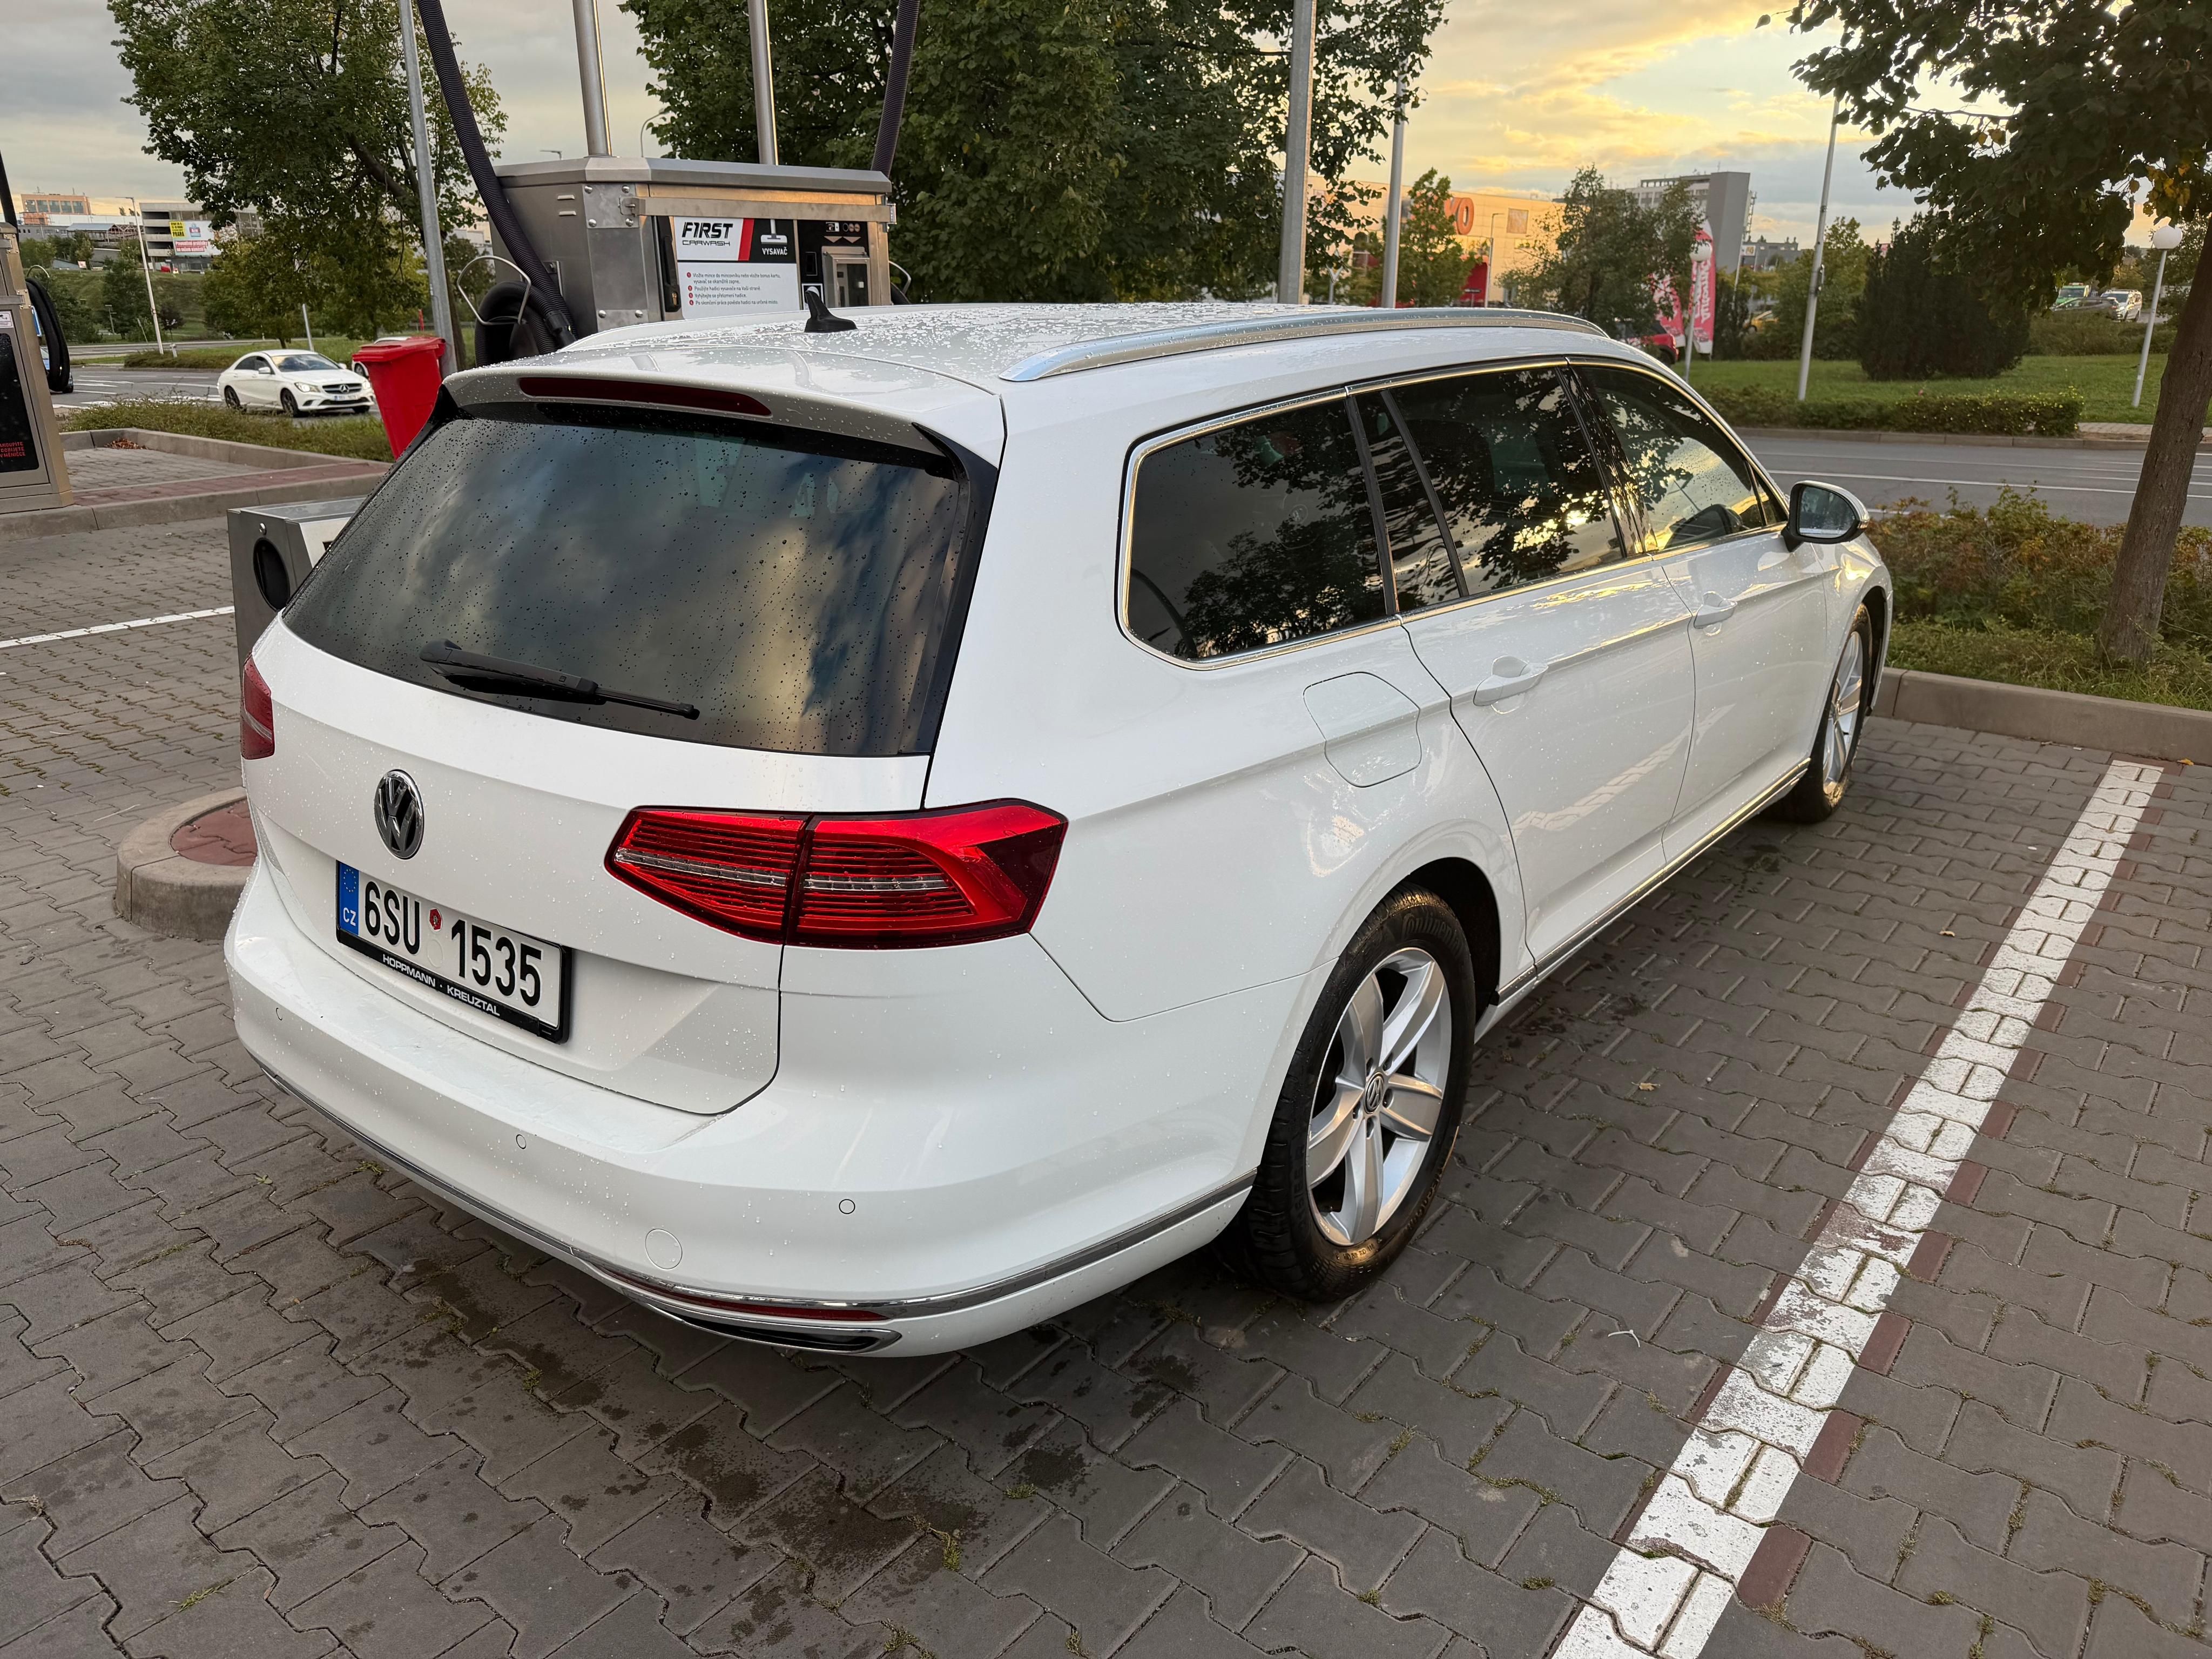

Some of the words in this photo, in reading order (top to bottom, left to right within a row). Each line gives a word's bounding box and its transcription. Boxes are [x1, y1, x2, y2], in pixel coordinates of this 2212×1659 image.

[762, 247, 788, 255] VYSAVAČ
[343, 907, 356, 927] CZ
[365, 881, 421, 955] 6SU
[451, 919, 542, 1007] 1535
[383, 954, 435, 987] HOPPMANN
[447, 986, 500, 1016] KREUZTAL
